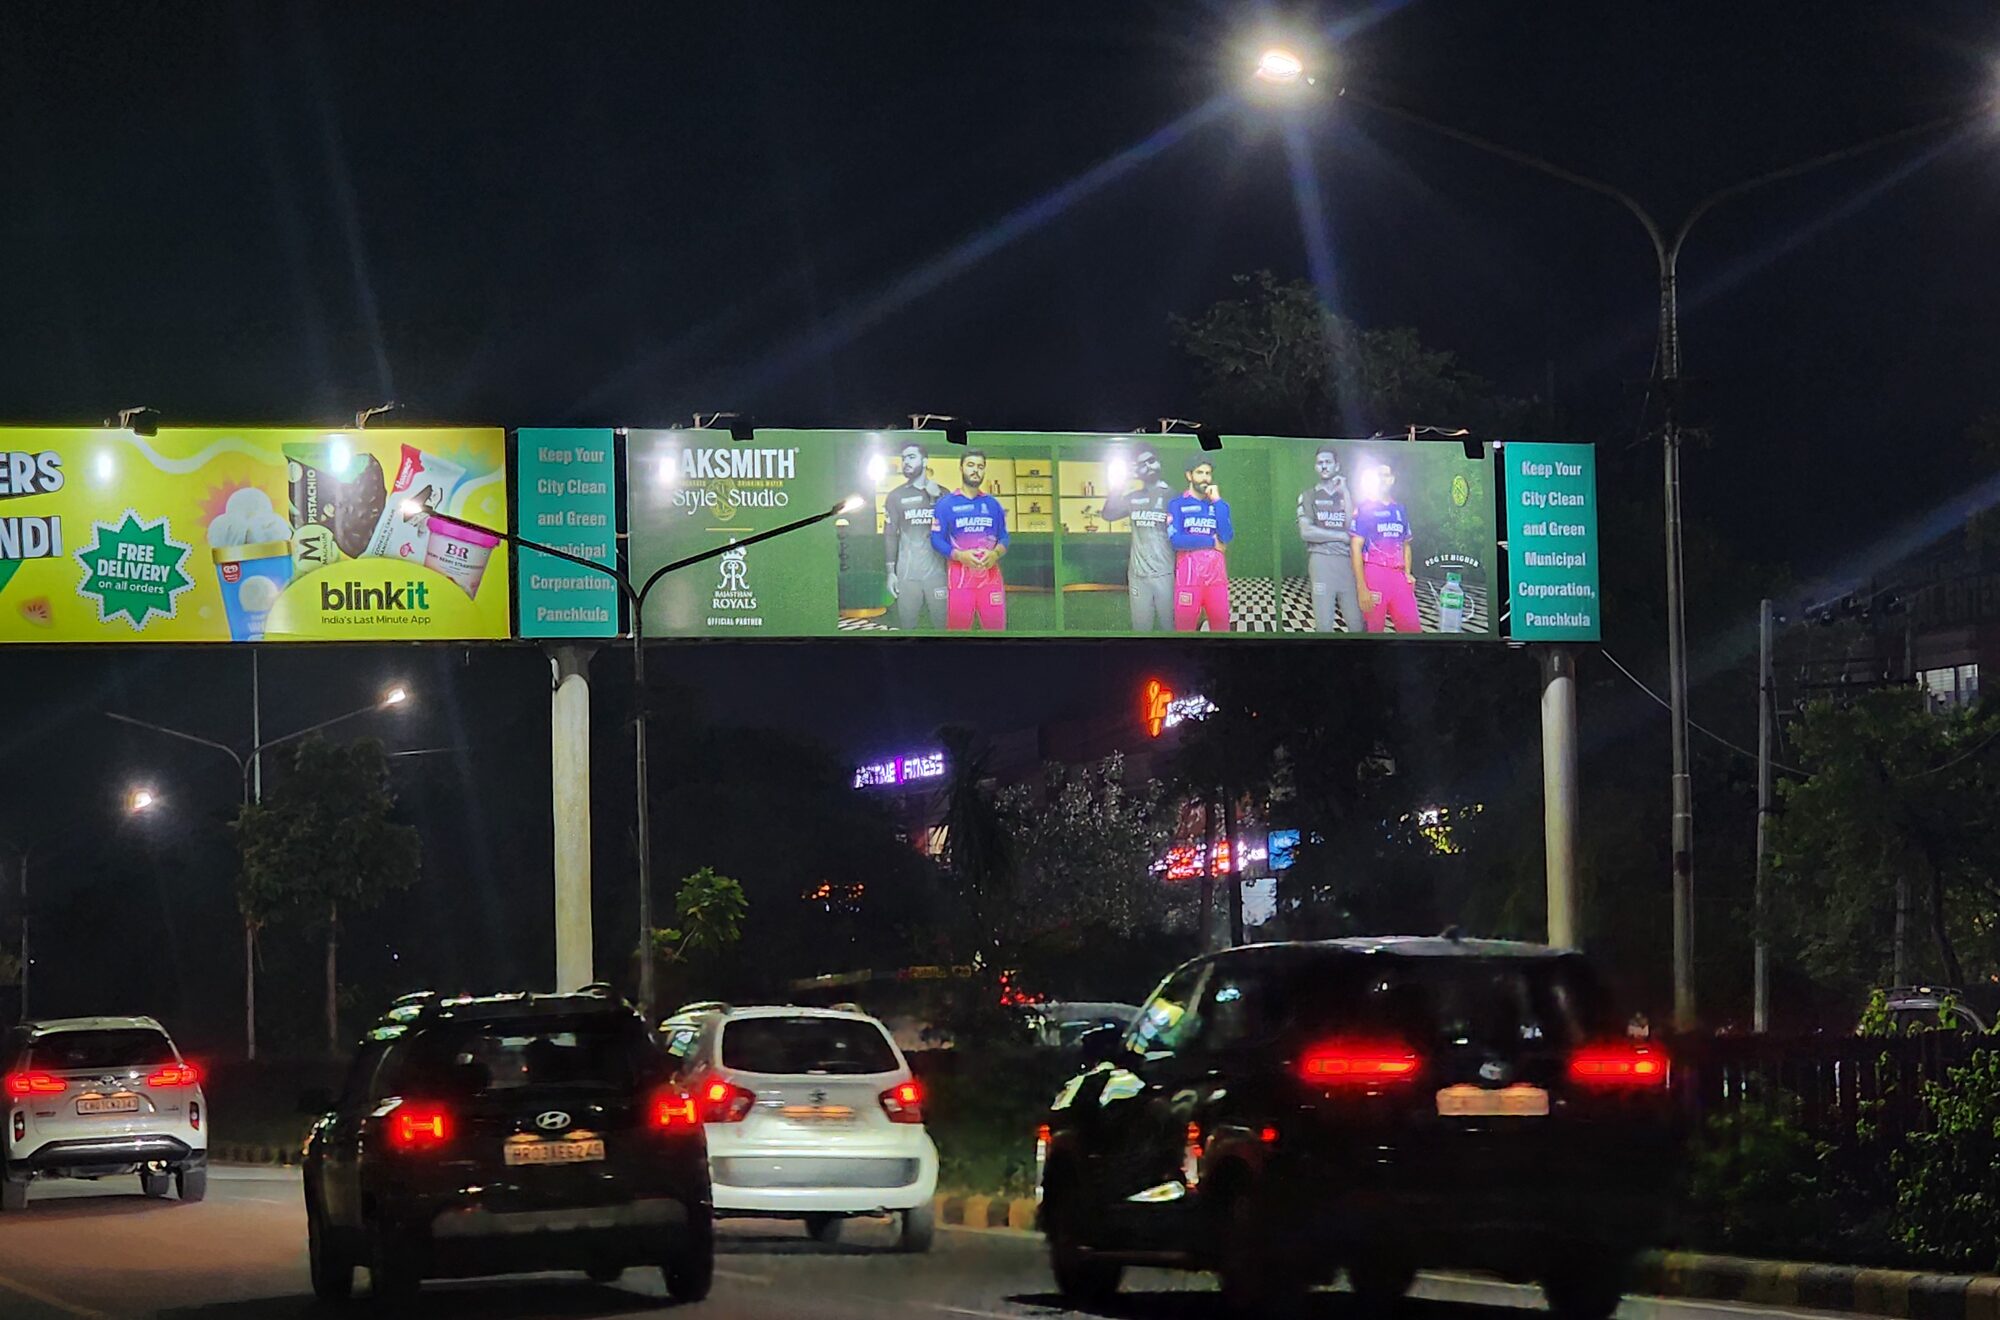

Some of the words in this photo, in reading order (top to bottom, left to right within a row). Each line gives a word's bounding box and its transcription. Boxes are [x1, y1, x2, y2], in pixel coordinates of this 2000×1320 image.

[538, 447, 573, 465] Keep
[575, 447, 605, 463] Your
[676, 447, 796, 479] AKSMITH
[1521, 461, 1553, 479] Keep
[1555, 461, 1582, 476] Your
[306, 469, 318, 524] PISTACHIO
[537, 479, 565, 497] City
[567, 479, 607, 495] Clean
[672, 488, 718, 516] Style
[727, 488, 789, 508] Studio
[1521, 491, 1547, 508] City
[1549, 491, 1585, 506] Clean
[537, 511, 564, 527] and
[567, 511, 607, 527] Green
[1190, 527, 1210, 535] SOLAR
[1523, 521, 1547, 536] and
[1549, 521, 1586, 536] Green
[117, 542, 155, 563] FREE
[1425, 557, 1440, 567] PEG
[1440, 554, 1449, 562] IT
[1450, 554, 1479, 568] HIGHER
[1524, 552, 1586, 568] Municipal
[97, 558, 170, 582] DELIVERY
[98, 581, 113, 589] on
[115, 580, 128, 591] all
[129, 583, 165, 594] orders
[530, 574, 615, 593] Corporation,
[1518, 582, 1596, 599] Corporation,
[320, 581, 430, 610] blinkit
[712, 598, 757, 609] ROYALS
[321, 616, 352, 625] India's
[354, 616, 374, 624] Last
[376, 616, 409, 624] Minute
[411, 616, 431, 626] App
[536, 606, 609, 623] Panchkula
[707, 617, 734, 626] OFFICIAL
[735, 617, 763, 626] PARTNER
[1526, 612, 1591, 627] Panchkula
